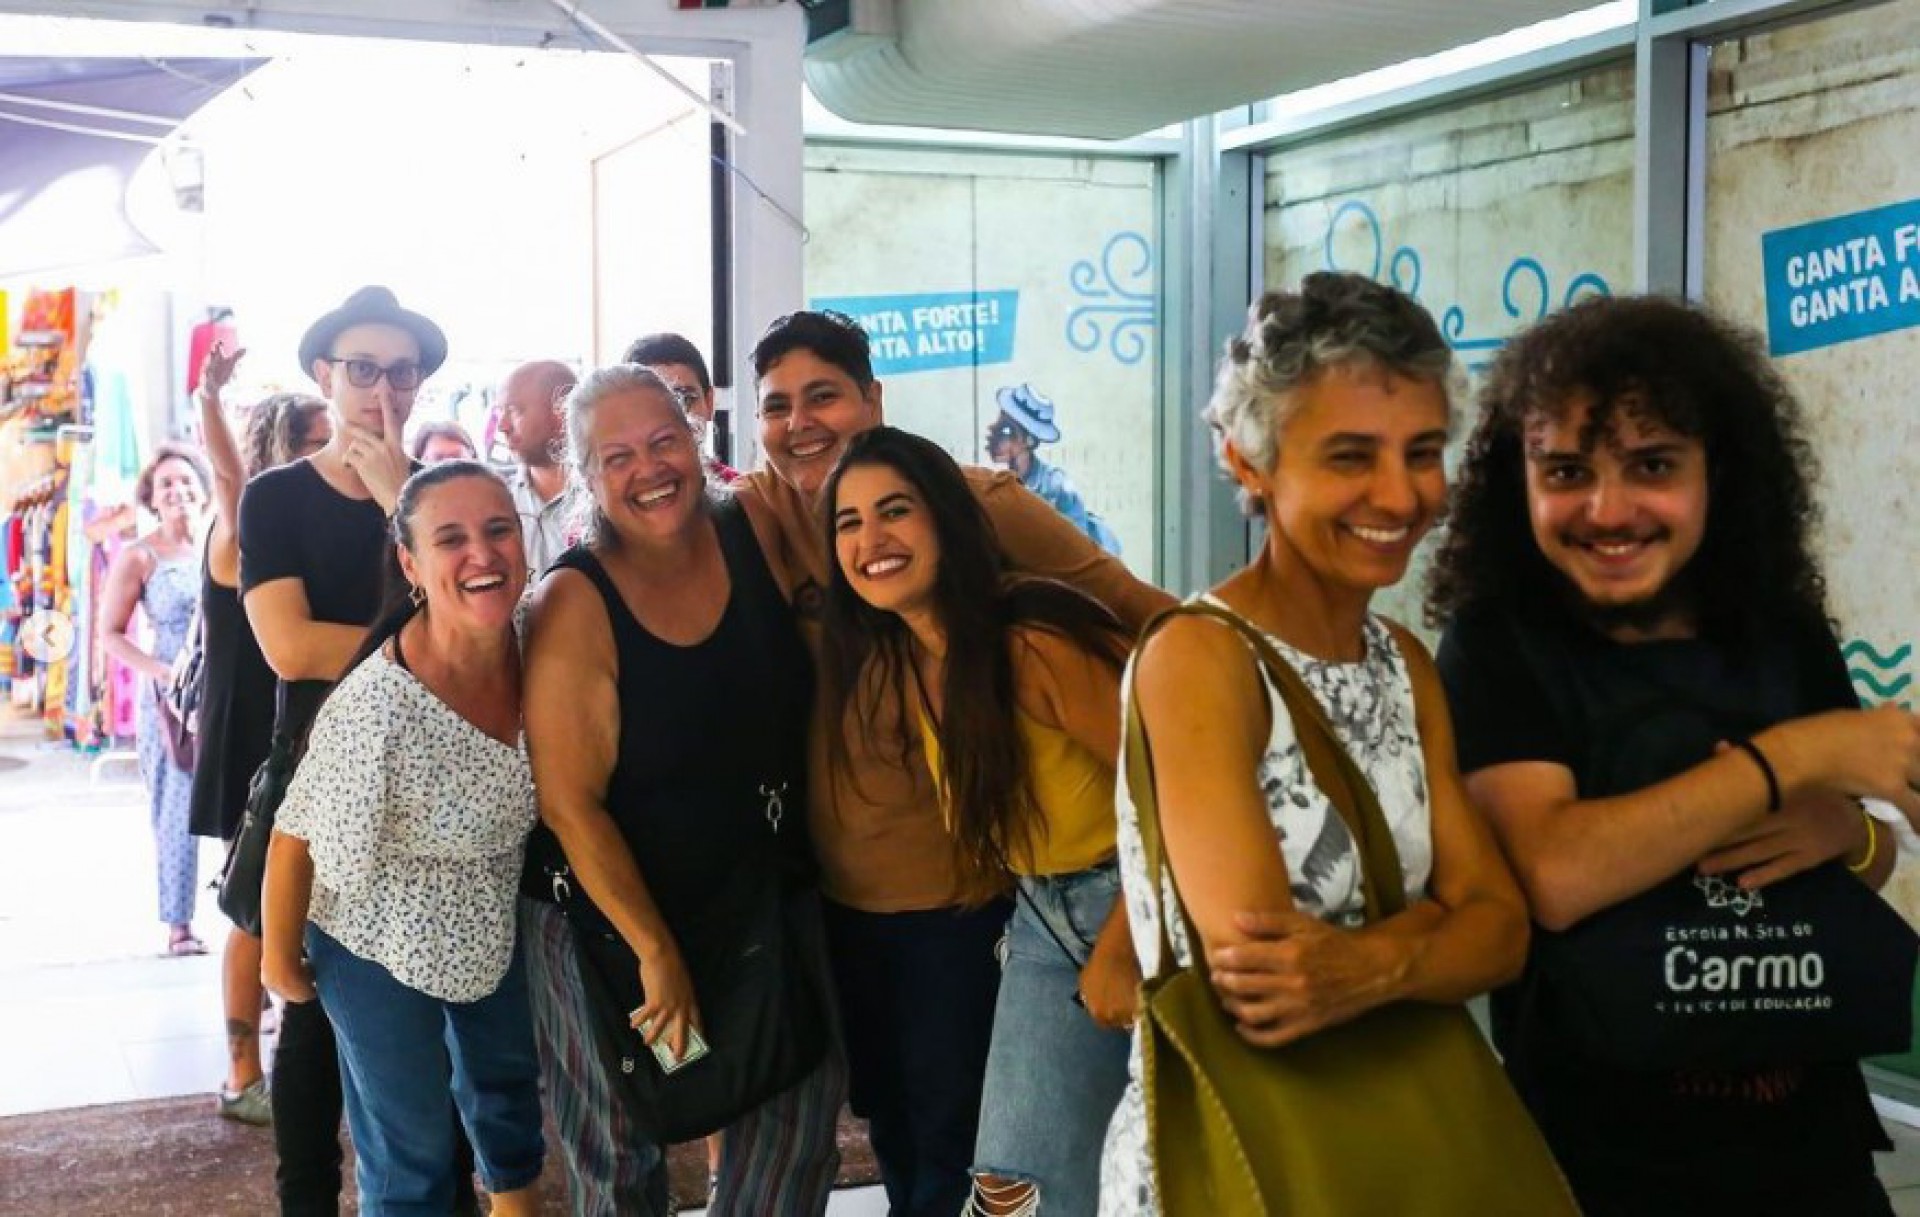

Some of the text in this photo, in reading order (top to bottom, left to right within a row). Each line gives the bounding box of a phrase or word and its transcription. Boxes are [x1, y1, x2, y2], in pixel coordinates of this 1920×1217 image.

[1787, 223, 1920, 288] CANTA F
[857, 300, 1000, 334] NTA FORTE!
[1790, 275, 1890, 328] CANTA
[917, 330, 985, 356] ALTO!
[1664, 945, 1825, 992] Carmo
